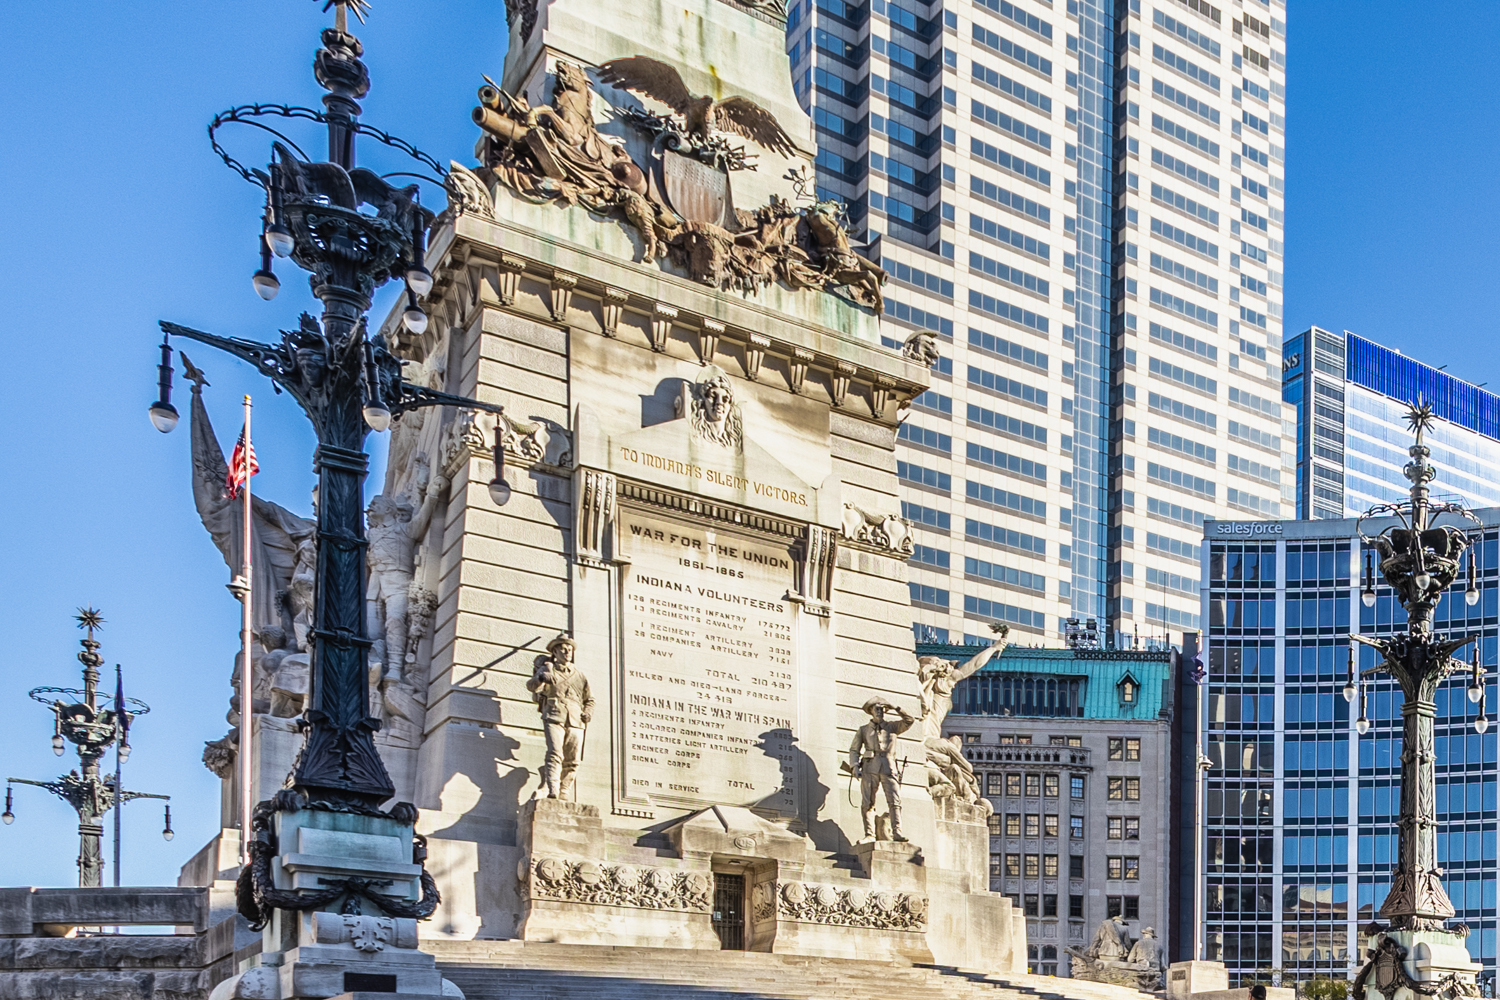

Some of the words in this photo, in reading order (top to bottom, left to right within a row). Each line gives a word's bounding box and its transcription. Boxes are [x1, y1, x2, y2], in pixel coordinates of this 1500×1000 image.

[620, 446, 637, 463] TO
[641, 452, 702, 479] INDIANA'S
[706, 470, 749, 491] SILENT
[753, 482, 808, 506] VICTORS.
[1217, 522, 1282, 537] salesforce
[630, 524, 664, 541] WAR
[670, 534, 701, 550] FOR
[707, 542, 738, 558] THE
[743, 550, 789, 570] UNION
[636, 574, 692, 594] INDIANA
[697, 587, 784, 613] VOLUNTEERS
[650, 598, 701, 614] REGIMENTS
[705, 609, 747, 623] INFANTRY
[650, 607, 701, 623] REGIMENTS
[705, 619, 744, 632] CAVALRY
[650, 623, 696, 637] REGIMENT
[704, 634, 753, 649] ARTILLERY
[650, 633, 702, 648] COMPANIES
[710, 644, 759, 659] ARTILLERY
[650, 649, 674, 659] NAVY
[629, 670, 663, 682] KILLED
[668, 677, 686, 686] AND
[705, 668, 740, 682] TOTAL
[630, 693, 672, 710] INDIANA
[674, 701, 684, 712] IN
[688, 703, 707, 716] THE
[710, 707, 732, 720] WAR
[734, 711, 760, 725] WITH
[762, 716, 794, 730] SPAIN.
[639, 711, 685, 724] REGIMENTS
[688, 718, 725, 730] INFANTRY
[639, 733, 681, 745] BATTERIES
[684, 740, 706, 749] LIGHT
[710, 744, 748, 755] ARTILLERY
[680, 729, 724, 741] COMPANIES
[632, 743, 669, 755] ENGINEER
[675, 750, 701, 759] CORPS
[632, 755, 659, 765] SIGNAL
[667, 760, 691, 769] CORPS
[632, 778, 650, 787] DIED
[668, 783, 699, 794] SERVICE
[727, 780, 755, 790] TOTAL
